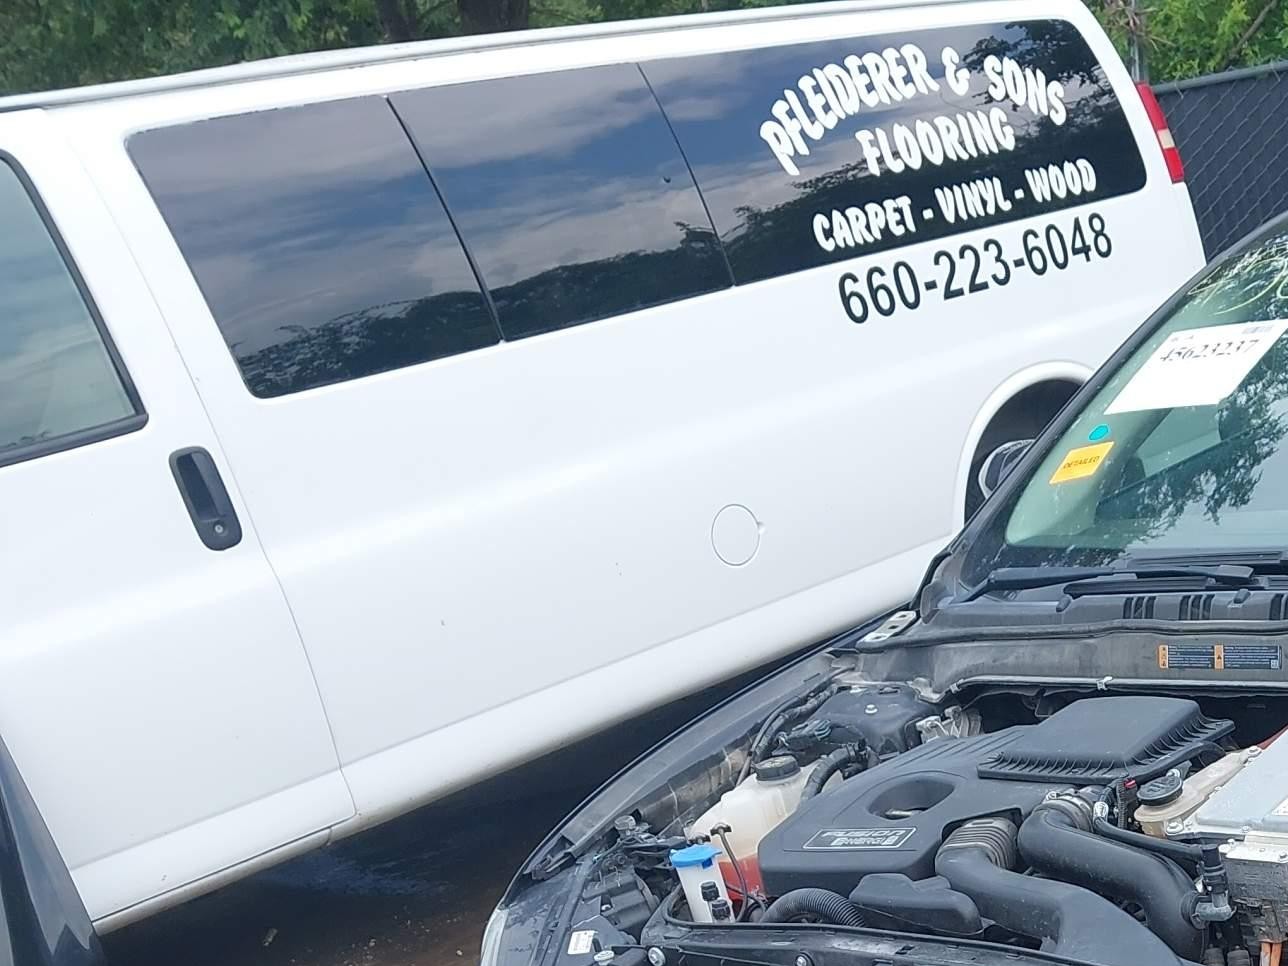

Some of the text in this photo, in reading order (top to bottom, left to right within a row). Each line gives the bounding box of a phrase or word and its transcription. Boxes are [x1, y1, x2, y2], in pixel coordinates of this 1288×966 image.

[760, 43, 1067, 177] PFLEIDERER & SONS
[855, 107, 1016, 178] FLOORING
[812, 196, 918, 253] CARPET
[934, 174, 1012, 225] VINYL
[1024, 157, 1098, 205] WOOD
[837, 212, 1114, 325] 660-223-6048
